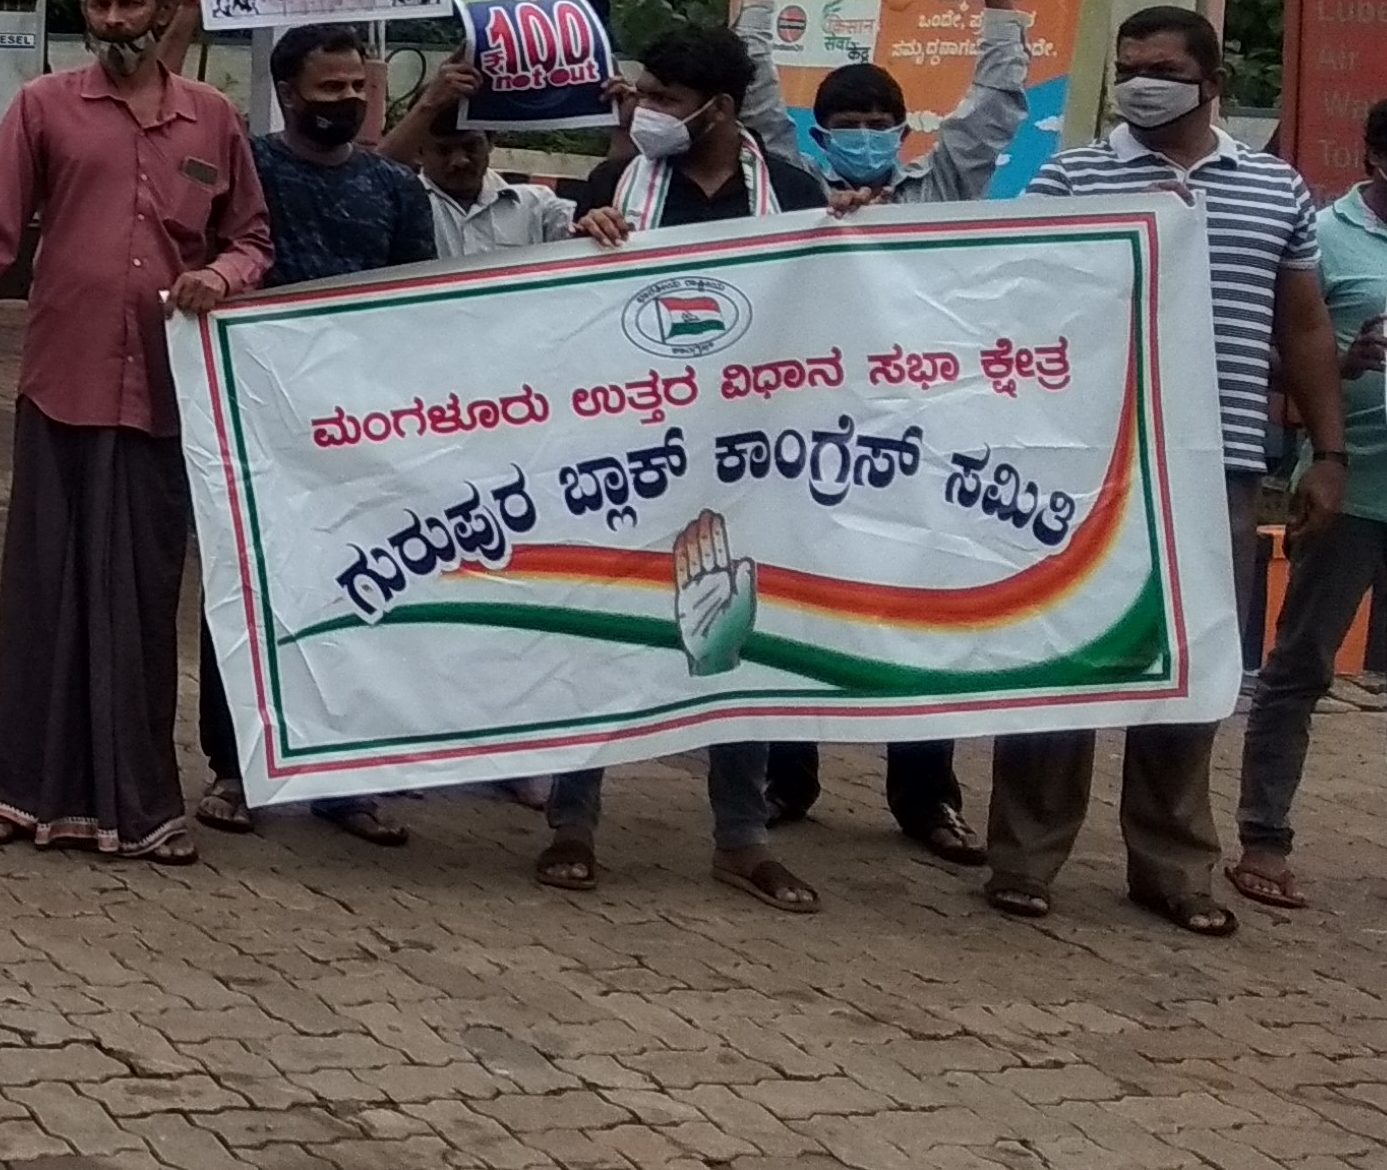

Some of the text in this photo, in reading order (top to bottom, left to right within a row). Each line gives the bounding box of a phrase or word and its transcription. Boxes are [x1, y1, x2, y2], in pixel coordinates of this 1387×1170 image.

[494, 60, 600, 90] not out
[310, 336, 1072, 450] ಮಂಗಳೂರು ಉತ್ತರ ವಿಧಾನ ಸಭಾ ಕ್ಷೇತ್ರ
[335, 414, 1078, 622] ಗುರುಪುರ ಬ್ಲಾಕ್ ಕಾಂಗ್ರೆಸ್ ಸಮಿತಿ
